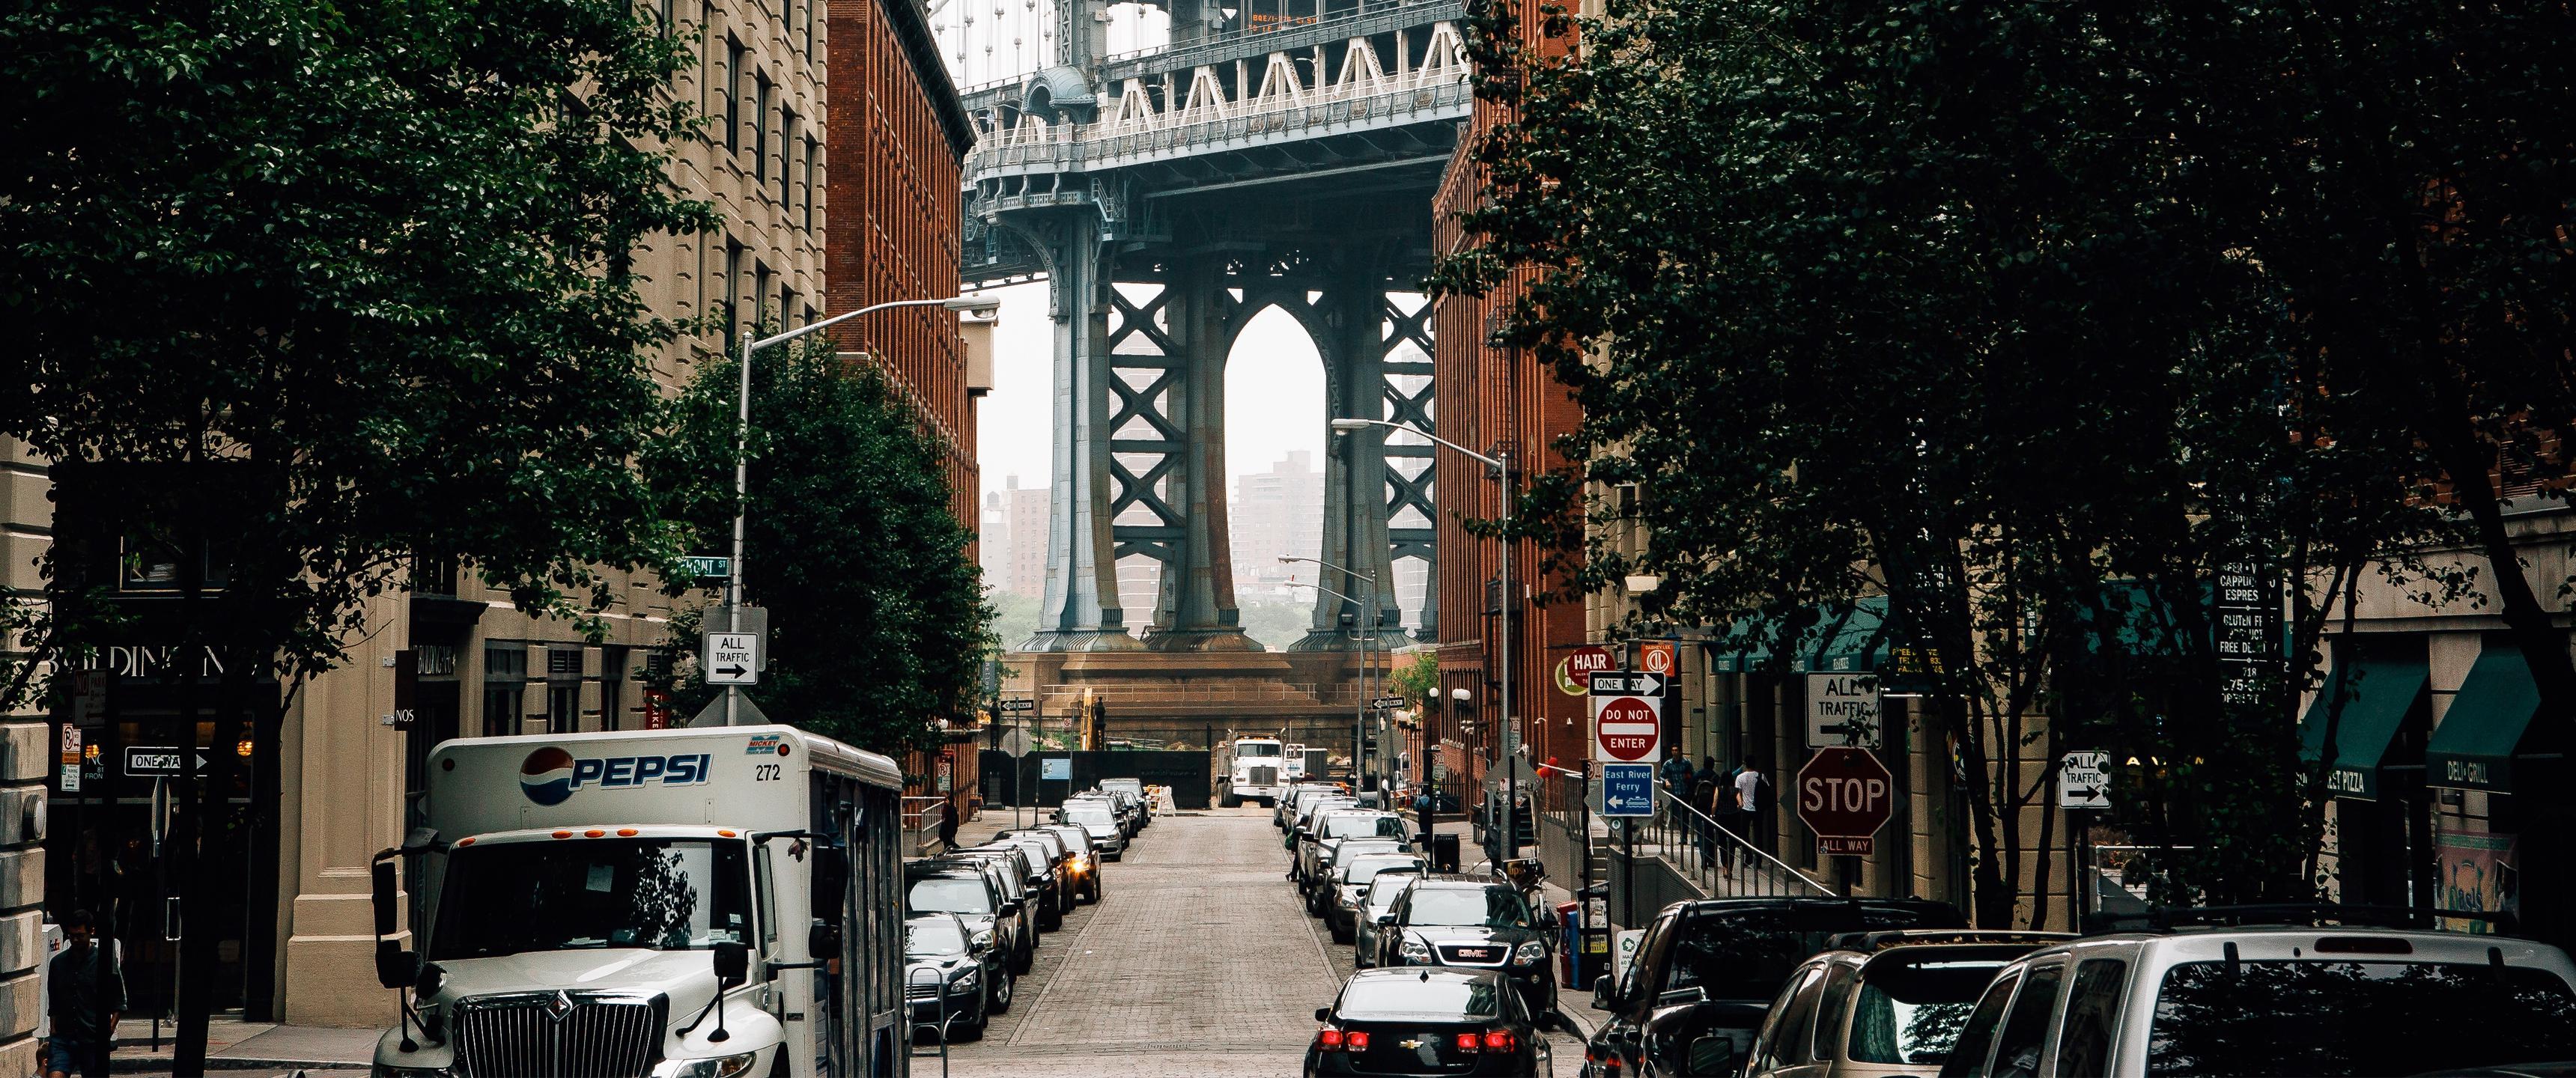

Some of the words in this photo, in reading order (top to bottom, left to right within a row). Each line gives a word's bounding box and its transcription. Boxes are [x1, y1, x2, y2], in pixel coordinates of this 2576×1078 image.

[718, 560, 726, 568] ST
[2225, 589, 2270, 602] ESPRES
[2223, 615, 2251, 627] GLUTEN
[720, 637, 745, 649] ALL
[2220, 642, 2239, 653] FREE
[716, 653, 750, 662] TRAFFIC
[1574, 654, 1607, 670] HAIR
[1598, 679, 1618, 689] ONE
[1623, 679, 1643, 689] AY
[1826, 678, 1862, 696] ALL
[1819, 701, 1869, 716] TRAFFIC
[395, 709, 414, 722] NOS
[1606, 710, 1621, 720] DO
[1627, 710, 1650, 720] NOT
[1610, 738, 1646, 749] ENTER
[136, 755, 159, 767] ONE
[163, 755, 180, 767] WA
[2075, 756, 2095, 769] ALL
[569, 754, 713, 790] PEPSI
[756, 764, 781, 782] 272
[1606, 770, 1624, 779] East
[1628, 770, 1651, 779] River
[2447, 761, 2464, 781] DELI
[2467, 762, 2488, 784] GRILL
[2067, 773, 2101, 784] TRAFFIC
[2342, 770, 2364, 793] PIZZA
[1616, 782, 1640, 793] Ferry
[1805, 777, 1886, 812] STOP
[1820, 840, 1842, 852] ALL
[1847, 840, 1870, 852] WAY
[1458, 949, 1488, 957] GMC
